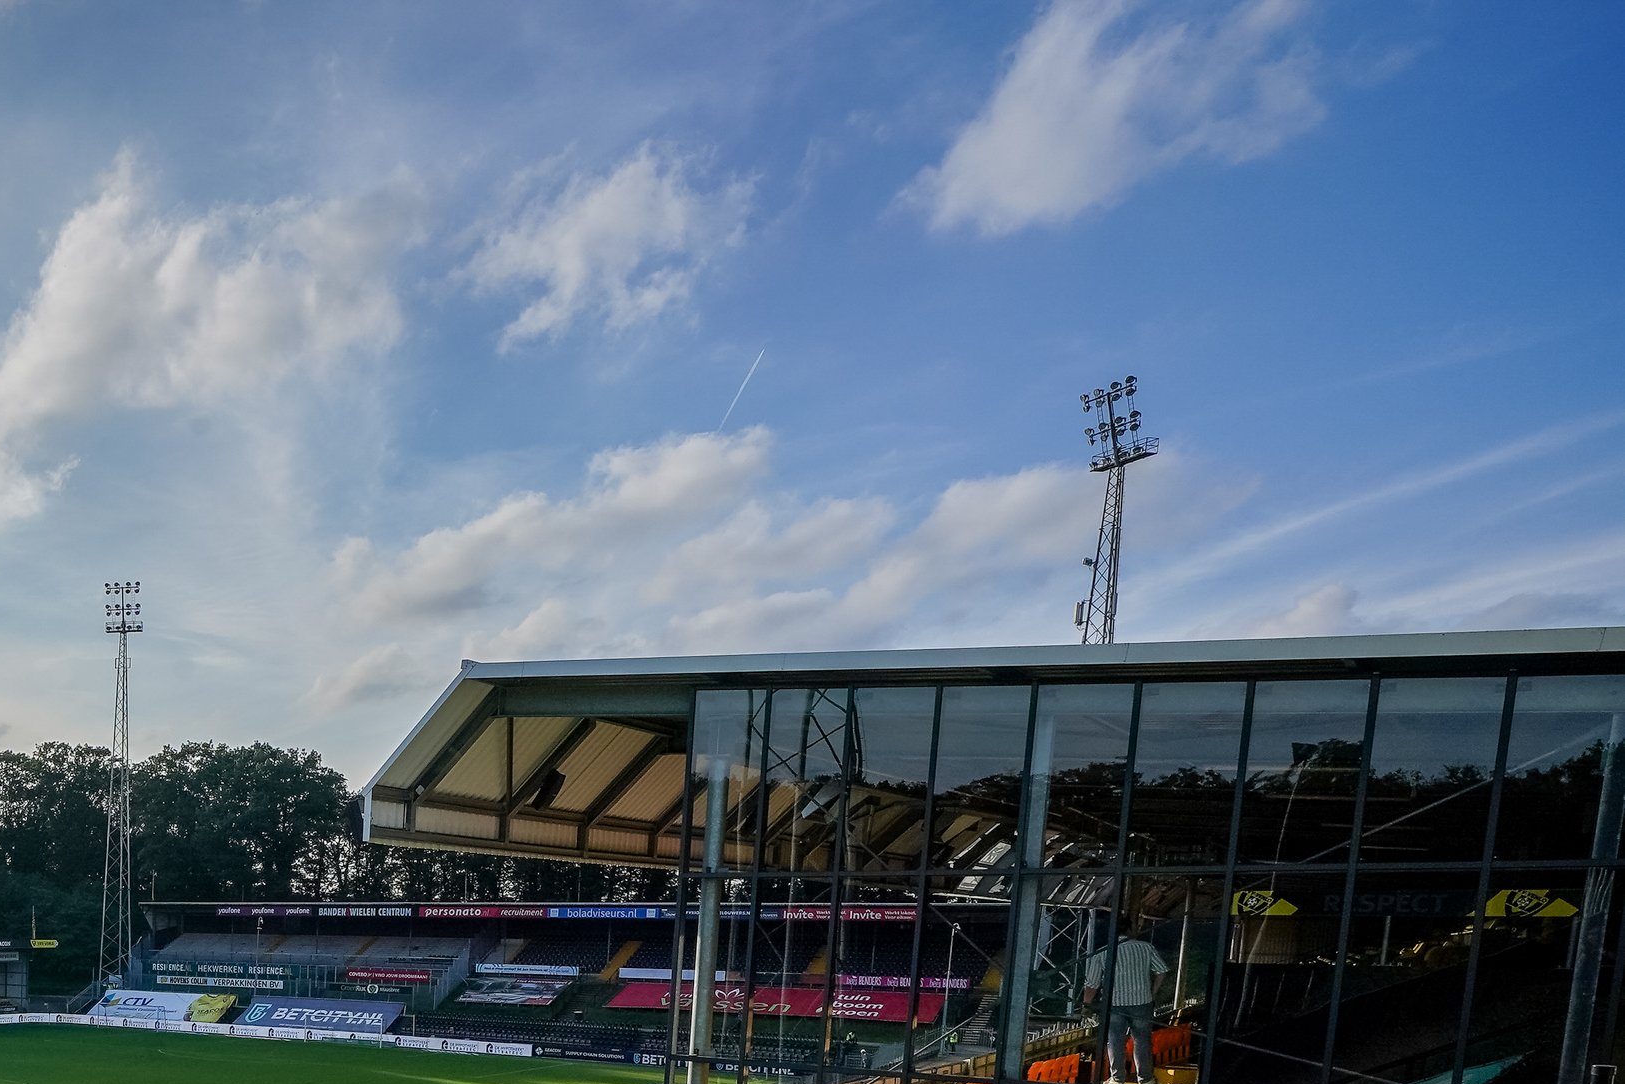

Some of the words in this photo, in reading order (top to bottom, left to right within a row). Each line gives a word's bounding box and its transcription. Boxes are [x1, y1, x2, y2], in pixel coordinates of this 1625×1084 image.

[218, 907, 240, 915] youfone
[251, 907, 274, 915] youfone
[285, 907, 310, 915] youfone
[319, 907, 347, 917] BANDEN
[350, 907, 376, 917] WIELEN
[378, 907, 412, 917] CENTRUM
[500, 908, 543, 916] recruitment
[567, 907, 637, 918] boladviseurs.nl
[197, 964, 244, 974] HEKWERKEN
[169, 977, 190, 985] HOVENS
[213, 978, 267, 988] VERPAKKINGEN
[269, 980, 280, 988] BV
[858, 976, 882, 986] BENDERS
[122, 997, 154, 1006] CTV
[832, 1001, 884, 1010] boom
